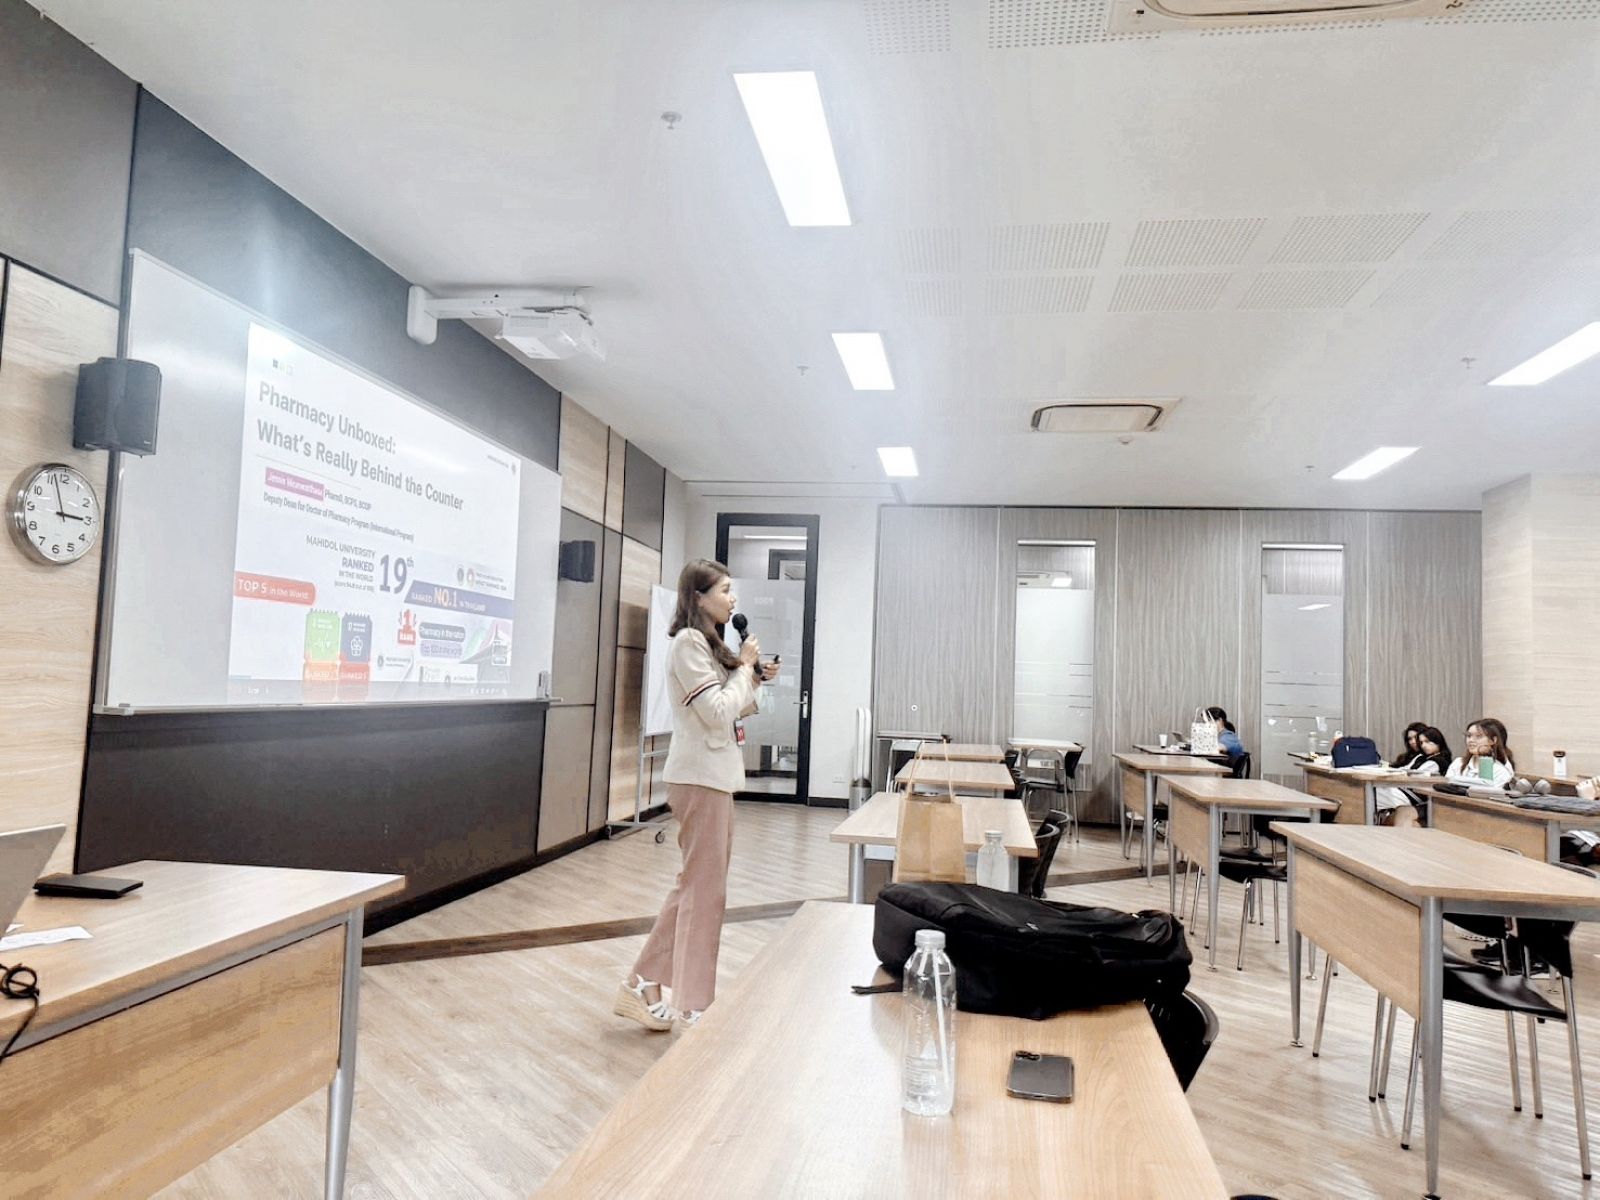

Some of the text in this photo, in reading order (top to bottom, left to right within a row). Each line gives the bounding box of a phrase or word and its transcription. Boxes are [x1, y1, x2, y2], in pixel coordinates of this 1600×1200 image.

[259, 381, 396, 455] Pharmacy Unboxed:
[257, 418, 464, 510] What's Really Behind the Counter
[47, 475, 54, 485] 11
[60, 474, 70, 484] 12
[34, 485, 43, 495] 10
[27, 501, 35, 511] 9
[82, 498, 90, 508] 2
[28, 521, 38, 531] 8
[84, 516, 92, 526] 3
[38, 536, 46, 546] 7
[78, 533, 86, 541] 4
[52, 545, 60, 554] 6
[66, 543, 75, 552] 5
[306, 535, 376, 560] MAHIDOL UNIVERSITY
[341, 557, 374, 573] RANKED
[238, 578, 259, 593] TOP
[261, 582, 267, 594] 5
[434, 587, 457, 609] NO.1
